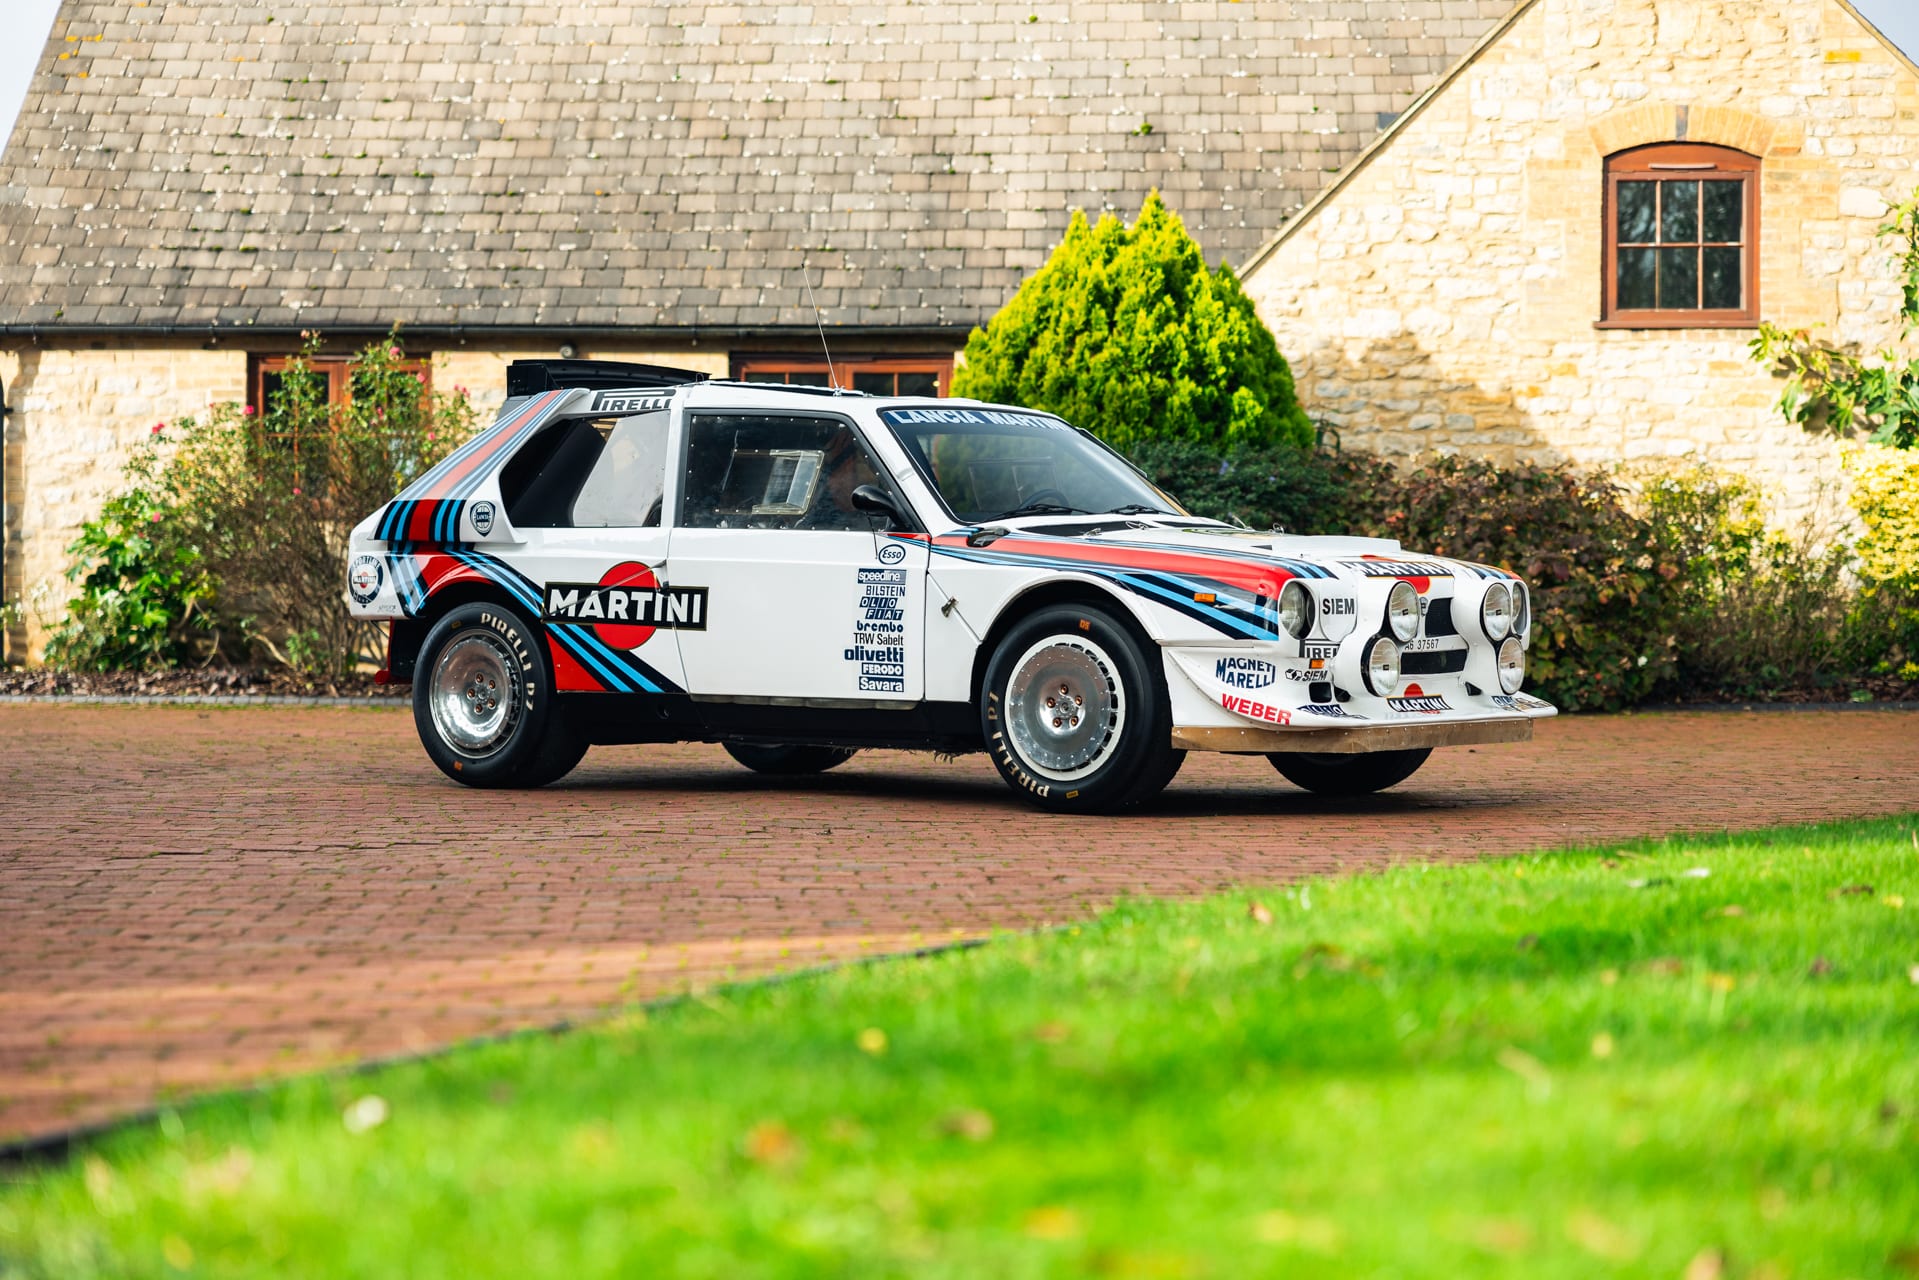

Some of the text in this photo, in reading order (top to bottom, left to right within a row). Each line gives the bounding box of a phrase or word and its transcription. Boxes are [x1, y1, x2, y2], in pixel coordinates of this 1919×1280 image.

[591, 389, 676, 411] PIRELLI
[891, 410, 1069, 432] LANCIA MARTIN
[882, 549, 902, 559] Esso
[1342, 561, 1453, 576] MARTINI
[858, 570, 901, 583] speedline
[866, 585, 906, 597] BILSTEIN
[550, 589, 702, 623] MARTINI
[859, 597, 898, 608] OLIO
[1322, 598, 1355, 615] SIEM
[866, 609, 904, 620] FIAT
[856, 620, 903, 632] brembo
[480, 612, 532, 671] PIRELLI
[854, 633, 903, 646] TRW Sabelt
[1417, 639, 1439, 650] 37567
[844, 646, 904, 662] olivetti
[863, 664, 903, 675] FERODO
[1216, 657, 1276, 674] MAGNETI
[1216, 670, 1276, 689] MARELLI
[1302, 670, 1328, 682] SIEM
[860, 677, 903, 692] Savara
[1222, 693, 1292, 725] WEBER
[1389, 697, 1448, 712] MARTINI
[992, 731, 1051, 798] PIRELLI
